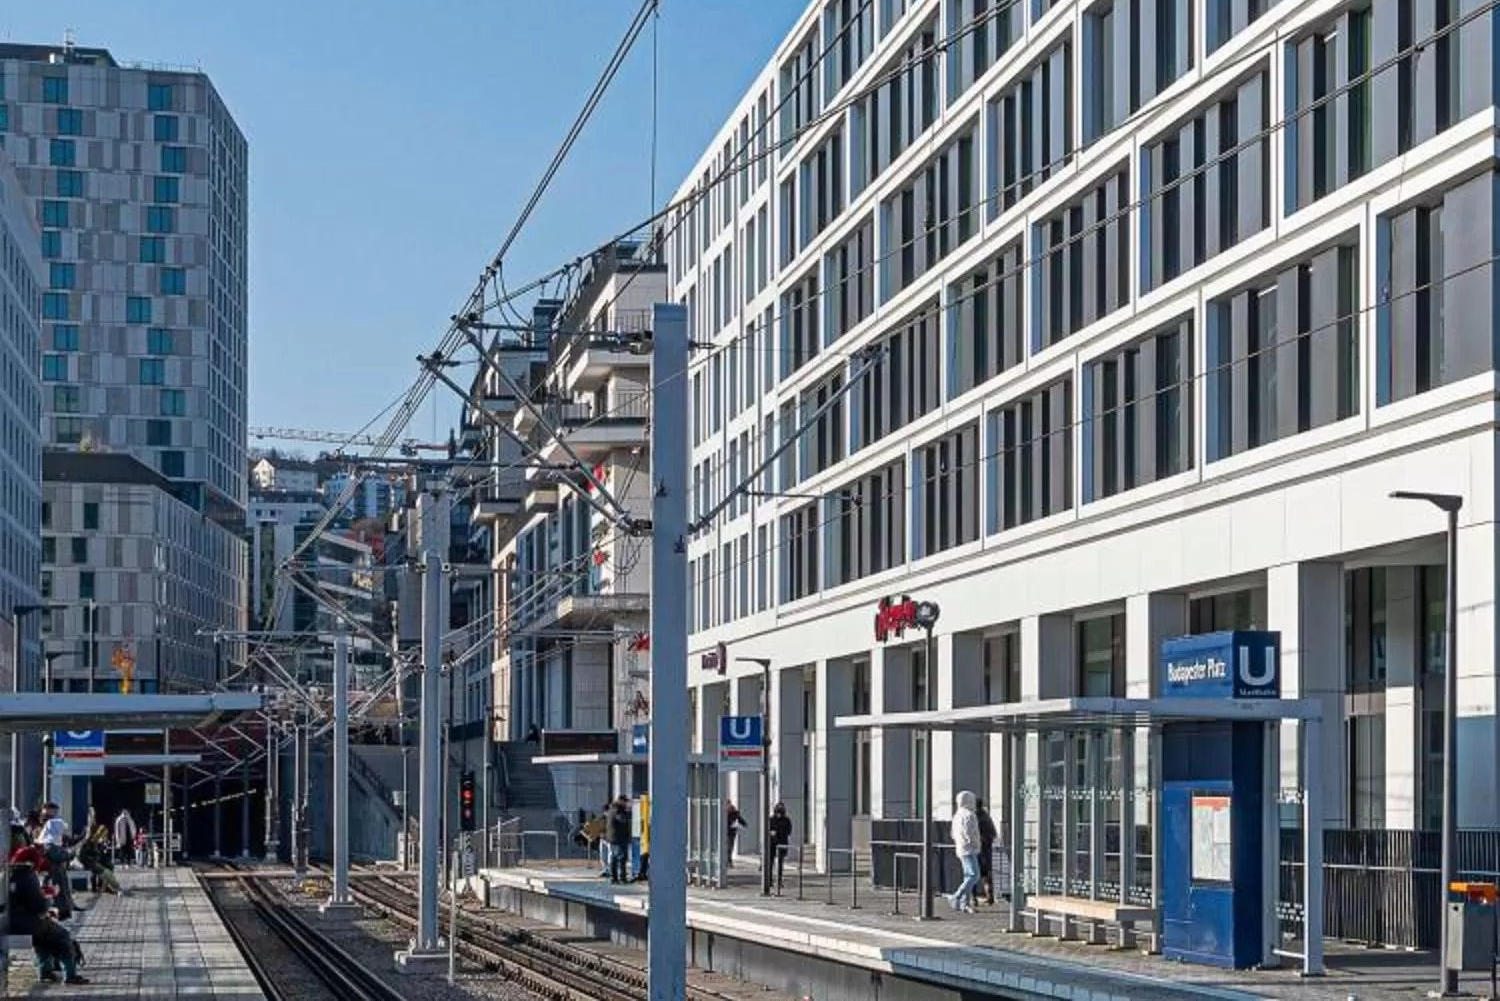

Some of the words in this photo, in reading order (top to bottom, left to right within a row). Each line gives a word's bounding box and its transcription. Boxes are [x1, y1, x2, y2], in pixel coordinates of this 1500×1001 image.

[1208, 658, 1226, 678] Platz
[1240, 646, 1275, 686] U
[729, 718, 751, 739] U
